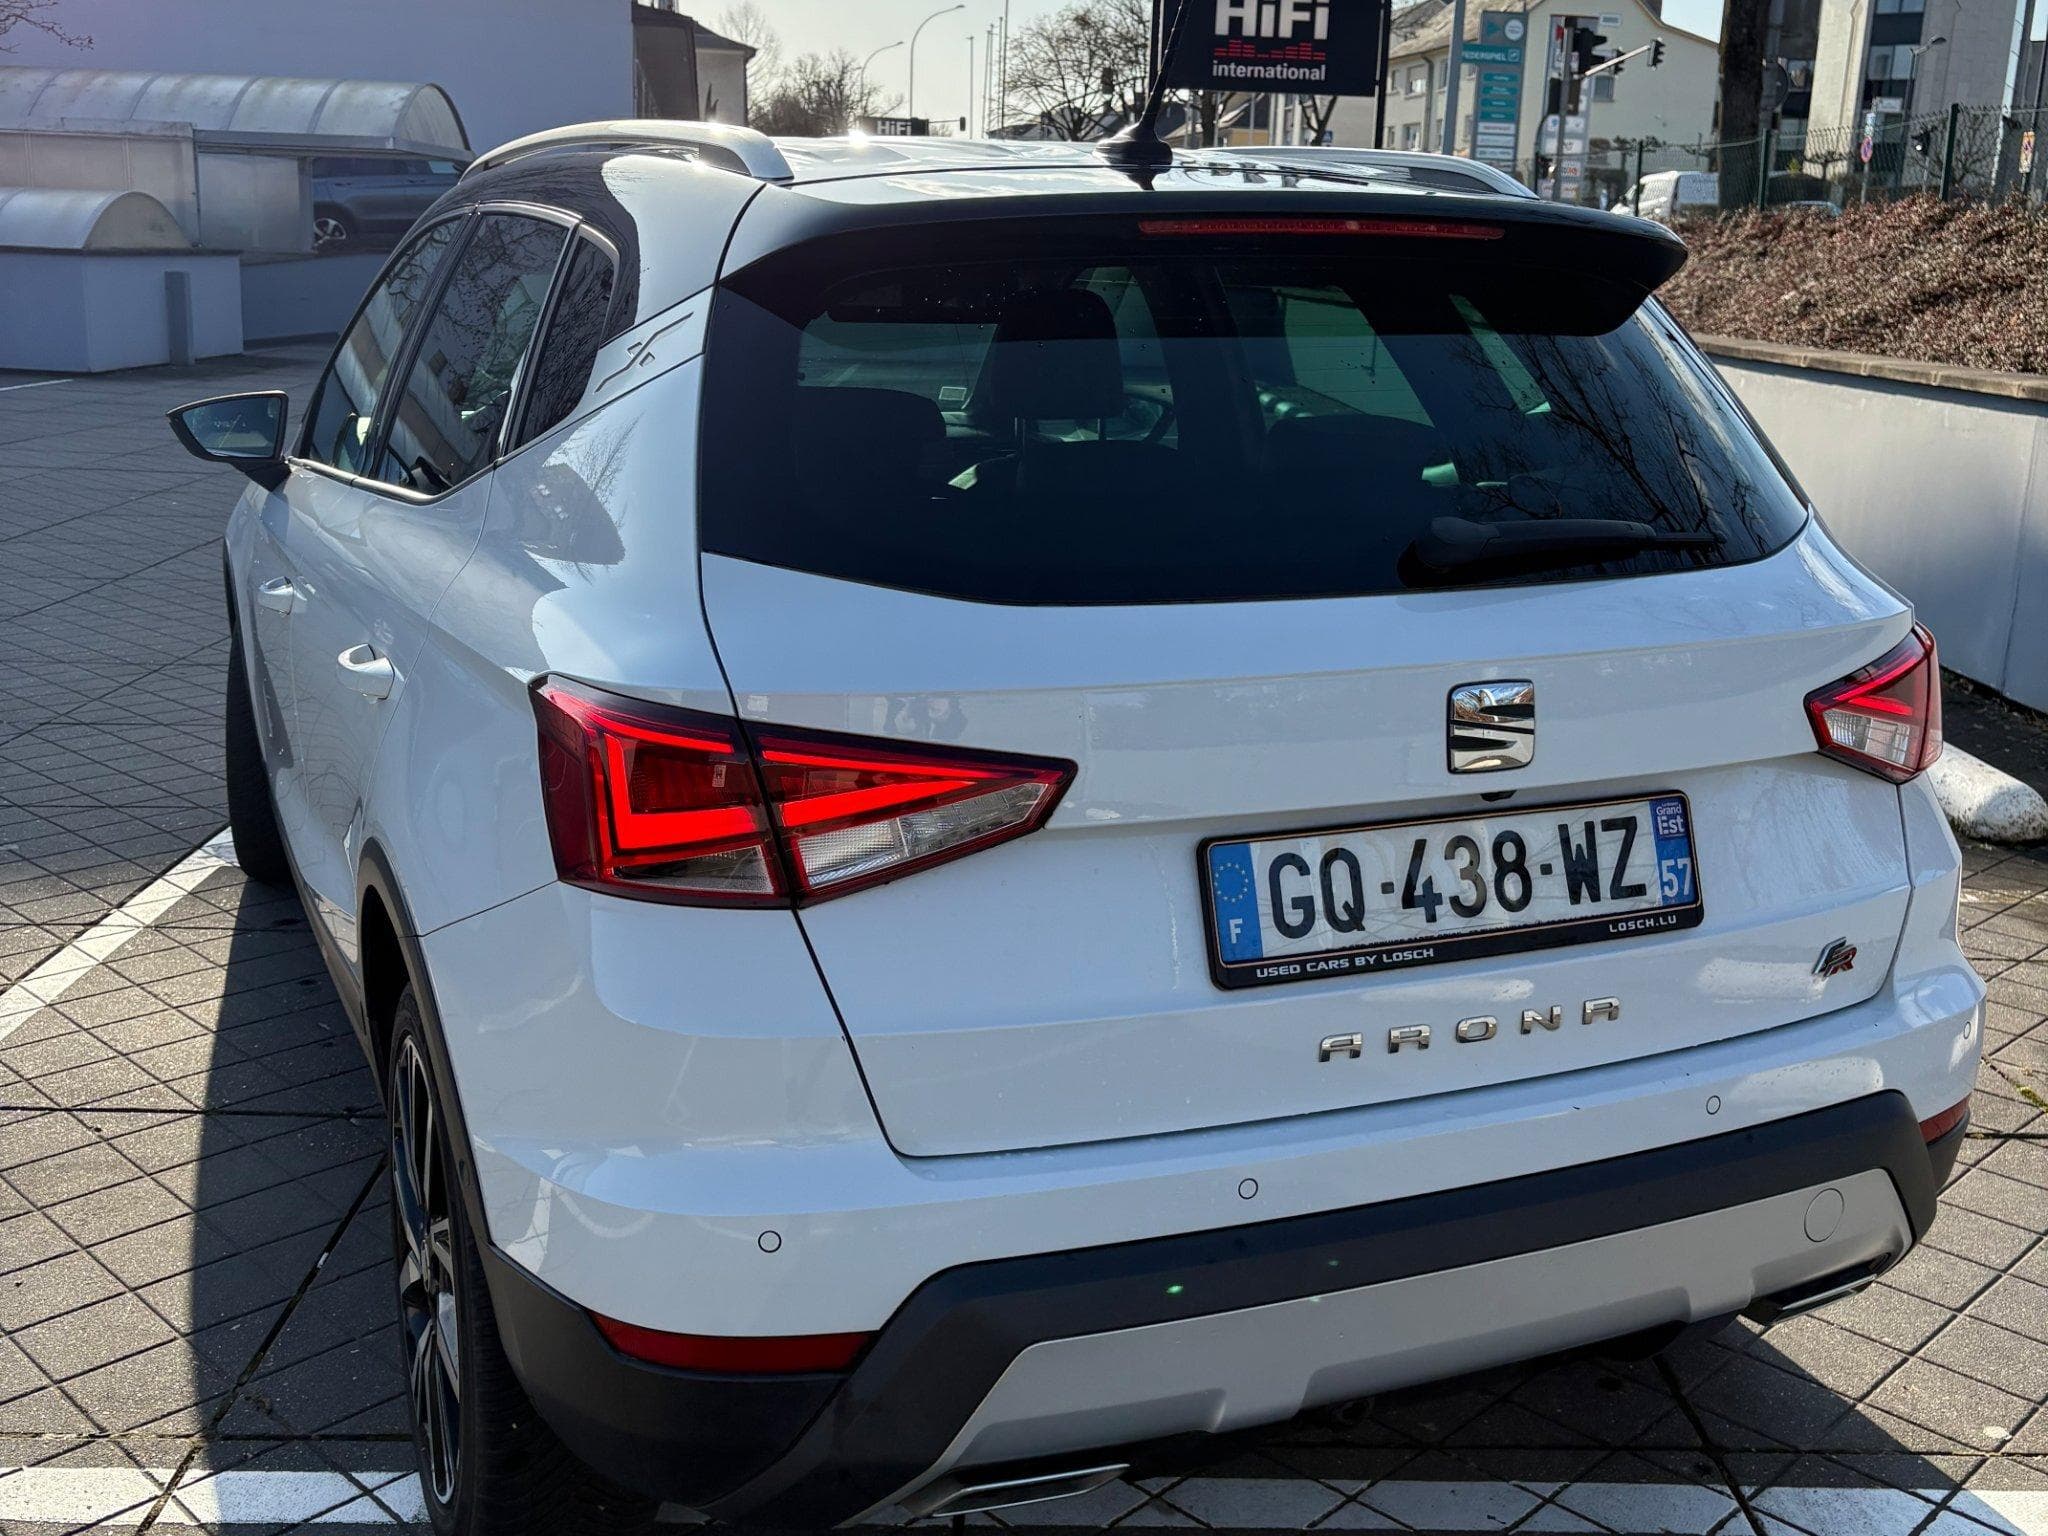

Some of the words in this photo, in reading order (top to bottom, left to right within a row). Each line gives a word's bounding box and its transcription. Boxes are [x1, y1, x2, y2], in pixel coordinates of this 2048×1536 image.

[1215, 0, 1330, 40] HiFi
[1212, 60, 1326, 80] international
[877, 120, 912, 135] HiFi
[1656, 804, 1682, 816] Grand
[1657, 814, 1685, 835] Est
[1661, 857, 1692, 897] 57
[1229, 918, 1243, 944] F
[1609, 914, 1677, 933] LOSCH.LU
[1256, 964, 1301, 979] USED
[1306, 958, 1350, 973] CARS
[1355, 954, 1377, 967] BY
[1383, 948, 1434, 963] LOSCH
[1318, 995, 1621, 1063] ARONA
